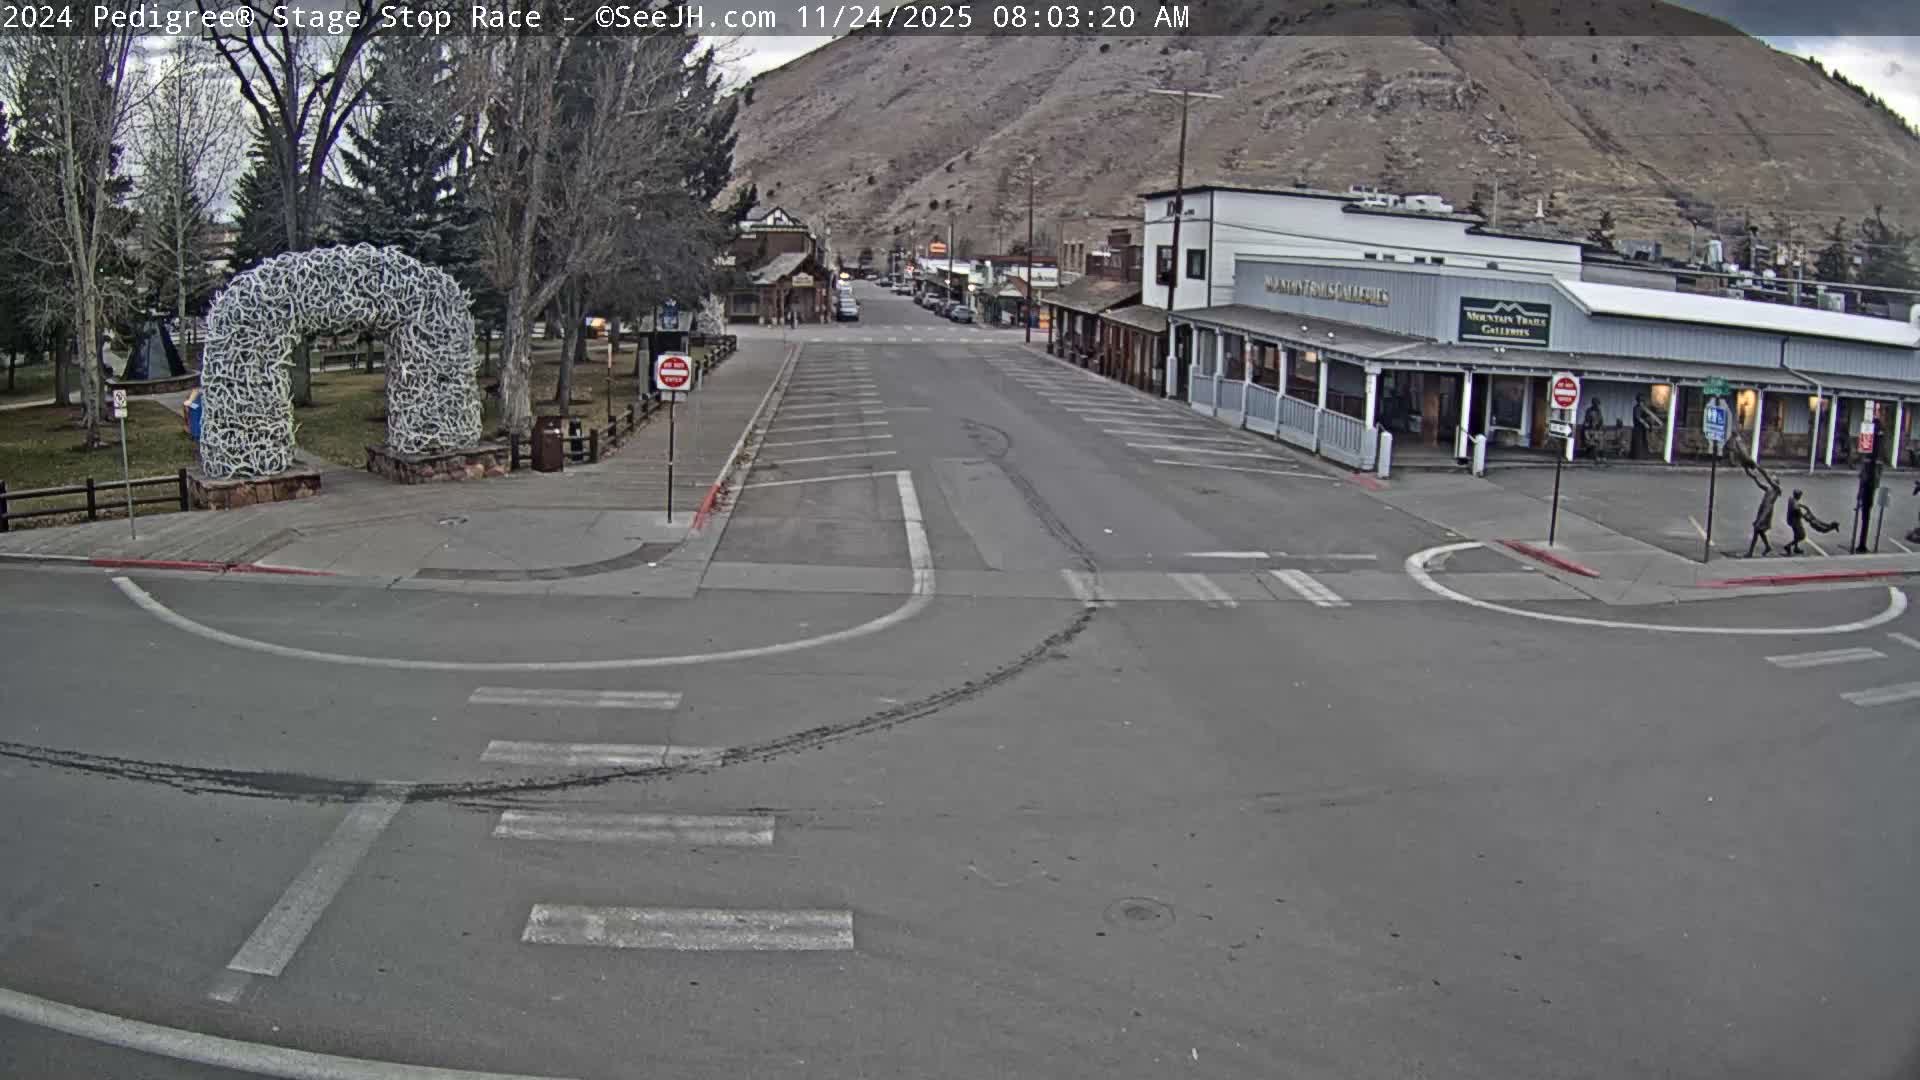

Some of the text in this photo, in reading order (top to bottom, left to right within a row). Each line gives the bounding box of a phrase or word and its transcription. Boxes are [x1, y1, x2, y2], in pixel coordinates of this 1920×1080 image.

[1466, 311, 1546, 327] MOUNTAIN TRAILS
[1481, 324, 1530, 337] GALLERIES
